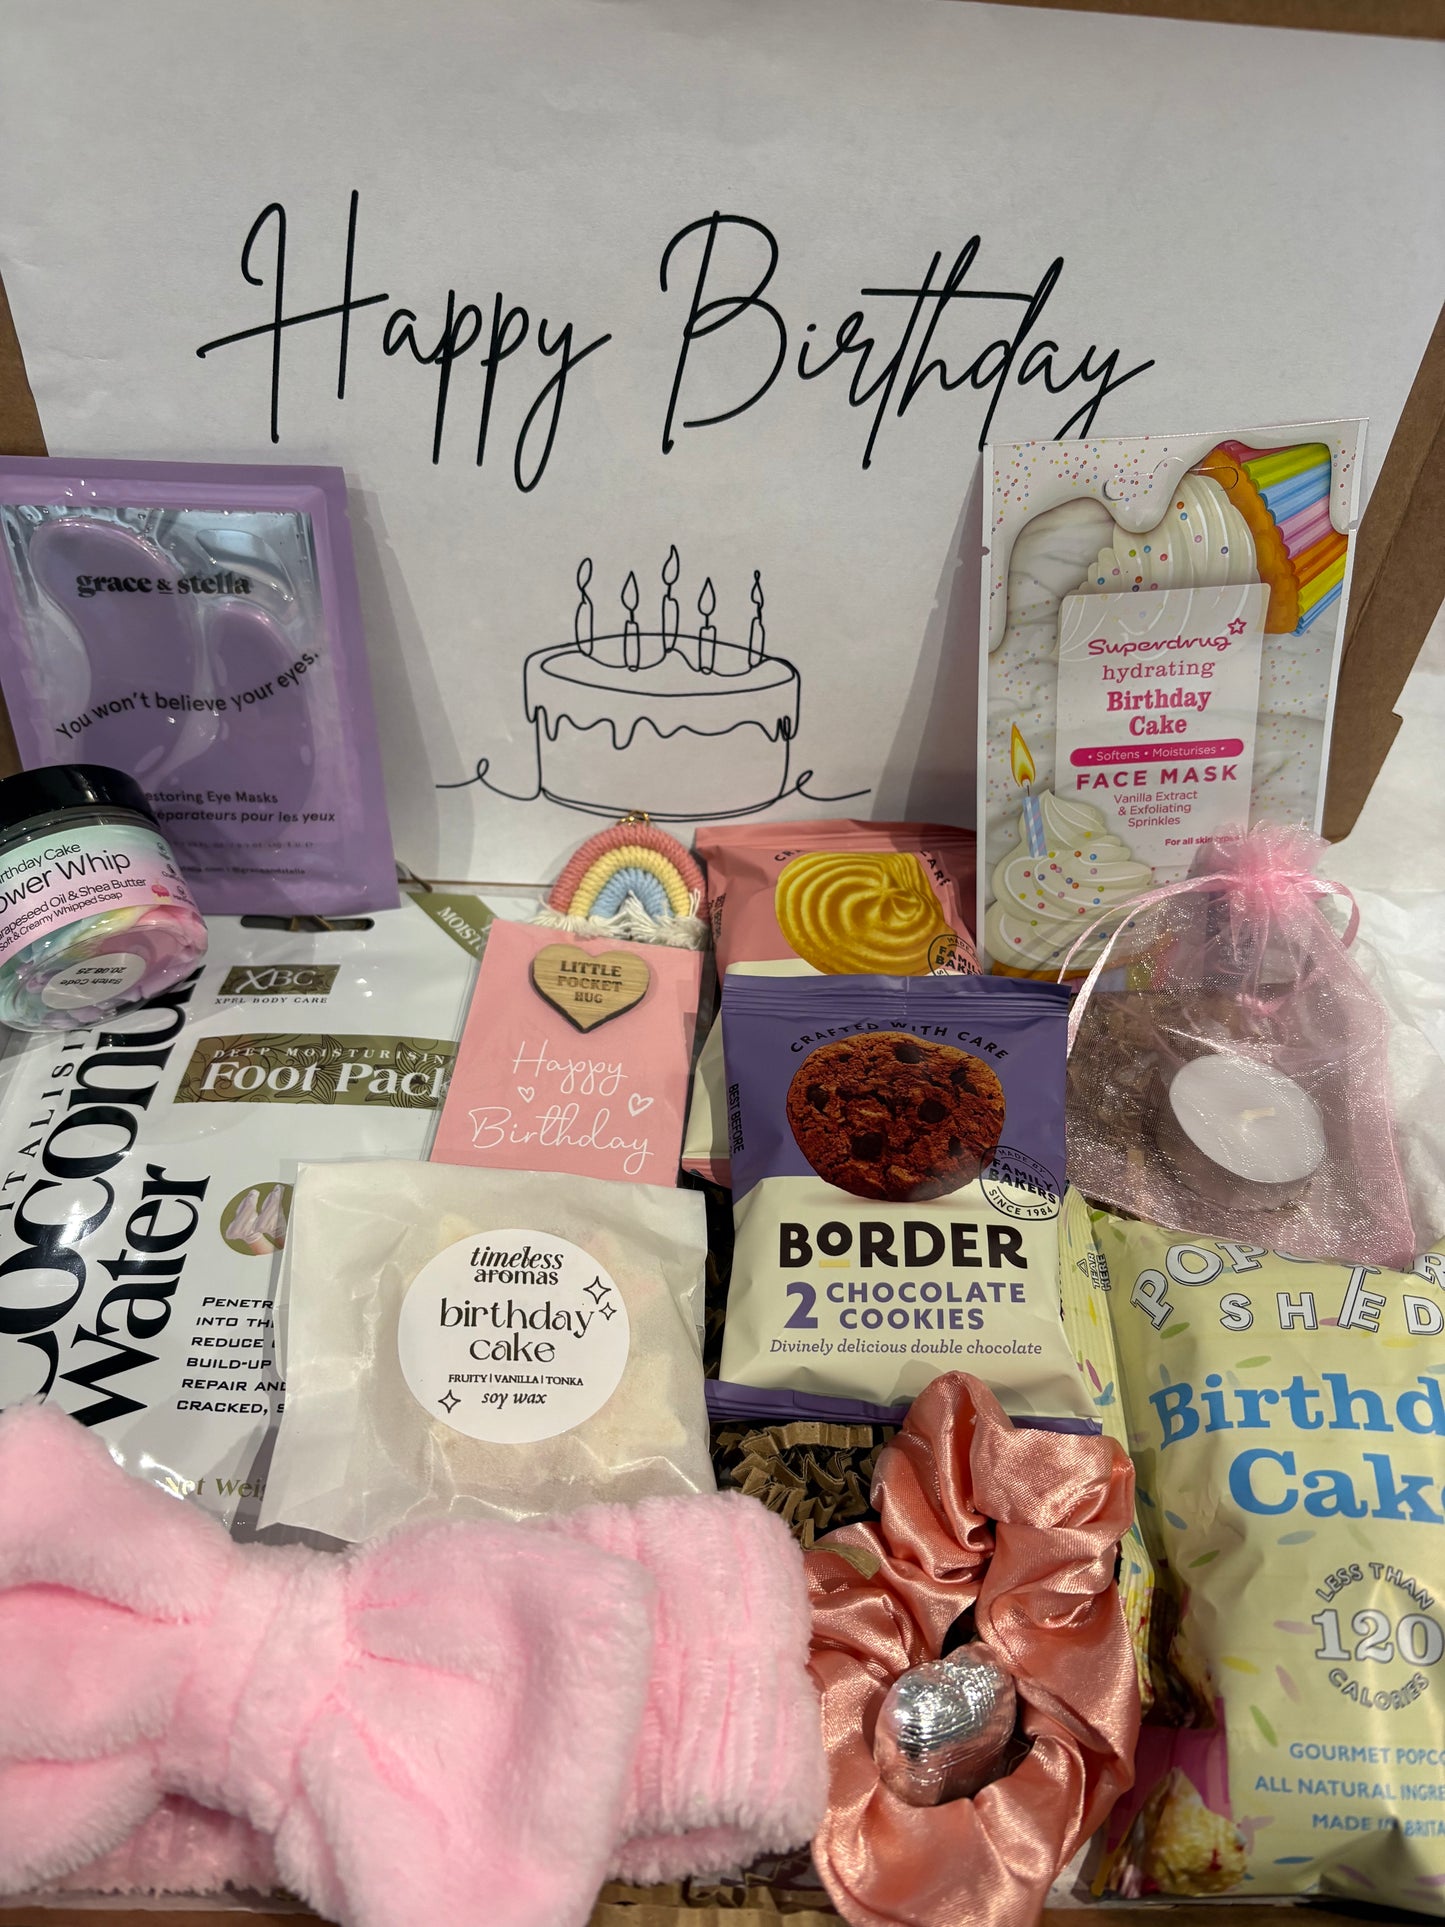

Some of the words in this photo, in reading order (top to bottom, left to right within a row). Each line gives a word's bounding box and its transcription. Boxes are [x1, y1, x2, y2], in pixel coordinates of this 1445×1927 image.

[196, 190, 611, 493] Happy
[659, 209, 1156, 470] Birthday
[76, 574, 153, 599] grace
[157, 576, 175, 595] &
[177, 571, 252, 596] stella
[1087, 634, 1232, 657] Superdrug
[1101, 660, 1216, 683] hydrating
[56, 713, 93, 742] You
[156, 691, 226, 712] believe
[230, 682, 274, 712] your
[277, 652, 319, 690] eyes.
[1106, 687, 1212, 712] Birthday
[1128, 714, 1188, 737] Cake
[1096, 750, 1140, 762] Softens
[1152, 745, 1217, 758] Moisturises
[1075, 769, 1148, 791] FACE
[1159, 764, 1239, 785] MASK
[145, 790, 202, 805] estoring
[207, 790, 232, 806] Eye
[236, 791, 279, 804] Masks
[1113, 792, 1152, 804] Vanilla
[1155, 790, 1198, 802] Extract
[1117, 806, 1127, 816] &
[1130, 802, 1192, 816] Exfoliating
[241, 811, 275, 824] pour
[278, 811, 299, 823] les
[302, 812, 336, 825] yeux
[1127, 816, 1181, 828] Sprinkles
[44, 844, 81, 861] Cake
[1164, 838, 1180, 847] For
[1182, 836, 1194, 846] all
[55, 849, 131, 881] Whip
[0, 901, 49, 939] rapeseed
[50, 893, 67, 908] Oil
[68, 890, 79, 901] &
[79, 883, 111, 897] Shea
[111, 879, 147, 890] Butter
[20, 913, 53, 936] Creamy
[53, 896, 98, 918] Whipped
[97, 891, 122, 903] Soap
[437, 906, 483, 952] MOIST
[235, 967, 317, 994] XBC
[560, 960, 622, 978] LITTLE
[556, 975, 623, 993] POCKET
[214, 997, 247, 1005] XPEL
[294, 997, 328, 1005] CARE
[574, 991, 604, 1004] HUG
[790, 1022, 879, 1053] CRAFTED
[890, 1021, 948, 1037] WITH
[957, 1030, 1009, 1061] CARE
[213, 1047, 271, 1058] DEEP
[286, 1046, 447, 1065] MOISTURISIN
[512, 1039, 629, 1097] Happy
[200, 1060, 322, 1092] Foot
[728, 1083, 741, 1111] BEST
[468, 1102, 655, 1175] Birthday
[731, 1111, 745, 1154] BEFORE
[988, 1168, 1057, 1205] BAKERS
[992, 1158, 1054, 1192] FAMILY
[989, 1189, 1021, 1215] SINCE
[1027, 1206, 1053, 1217] 1984
[470, 1245, 564, 1270] timeless
[779, 1221, 1028, 1269] BORDER
[473, 1268, 559, 1286] aromas
[1086, 1252, 1101, 1289] TEAR
[1095, 1253, 1111, 1291] HERE
[59, 1162, 211, 1427] Water
[202, 1297, 273, 1310] PENETR
[783, 1281, 819, 1329] 2
[826, 1281, 1026, 1303] CHOCOLATE
[196, 1317, 239, 1327] INTO
[440, 1297, 595, 1339] birthday
[839, 1308, 984, 1330] COOKIES
[191, 1337, 264, 1348] REDUCE
[469, 1332, 556, 1363] cake
[770, 1338, 833, 1356] Divinely
[837, 1339, 907, 1354] delicious
[910, 1339, 963, 1354] double
[966, 1339, 1042, 1355] chocolate
[186, 1357, 272, 1370] BUILD-UP
[181, 1378, 247, 1391] REPAIR
[448, 1374, 488, 1384] FRUITY
[494, 1375, 539, 1385] VANILLA
[545, 1376, 584, 1386] TONKA
[176, 1400, 269, 1415] CRACKED,
[481, 1391, 508, 1409] soy
[513, 1391, 548, 1404] wax
[1229, 1448, 1445, 1524] Cak
[1315, 1563, 1364, 1603] LESS
[1368, 1562, 1434, 1612] THAN
[1311, 1608, 1445, 1667] 120
[1328, 1667, 1430, 1712] CALORIES
[1289, 1742, 1390, 1764] GOURMET
[1255, 1776, 1292, 1793] ALL
[1297, 1778, 1396, 1800] NATURAL
[1312, 1813, 1371, 1831] MADE
